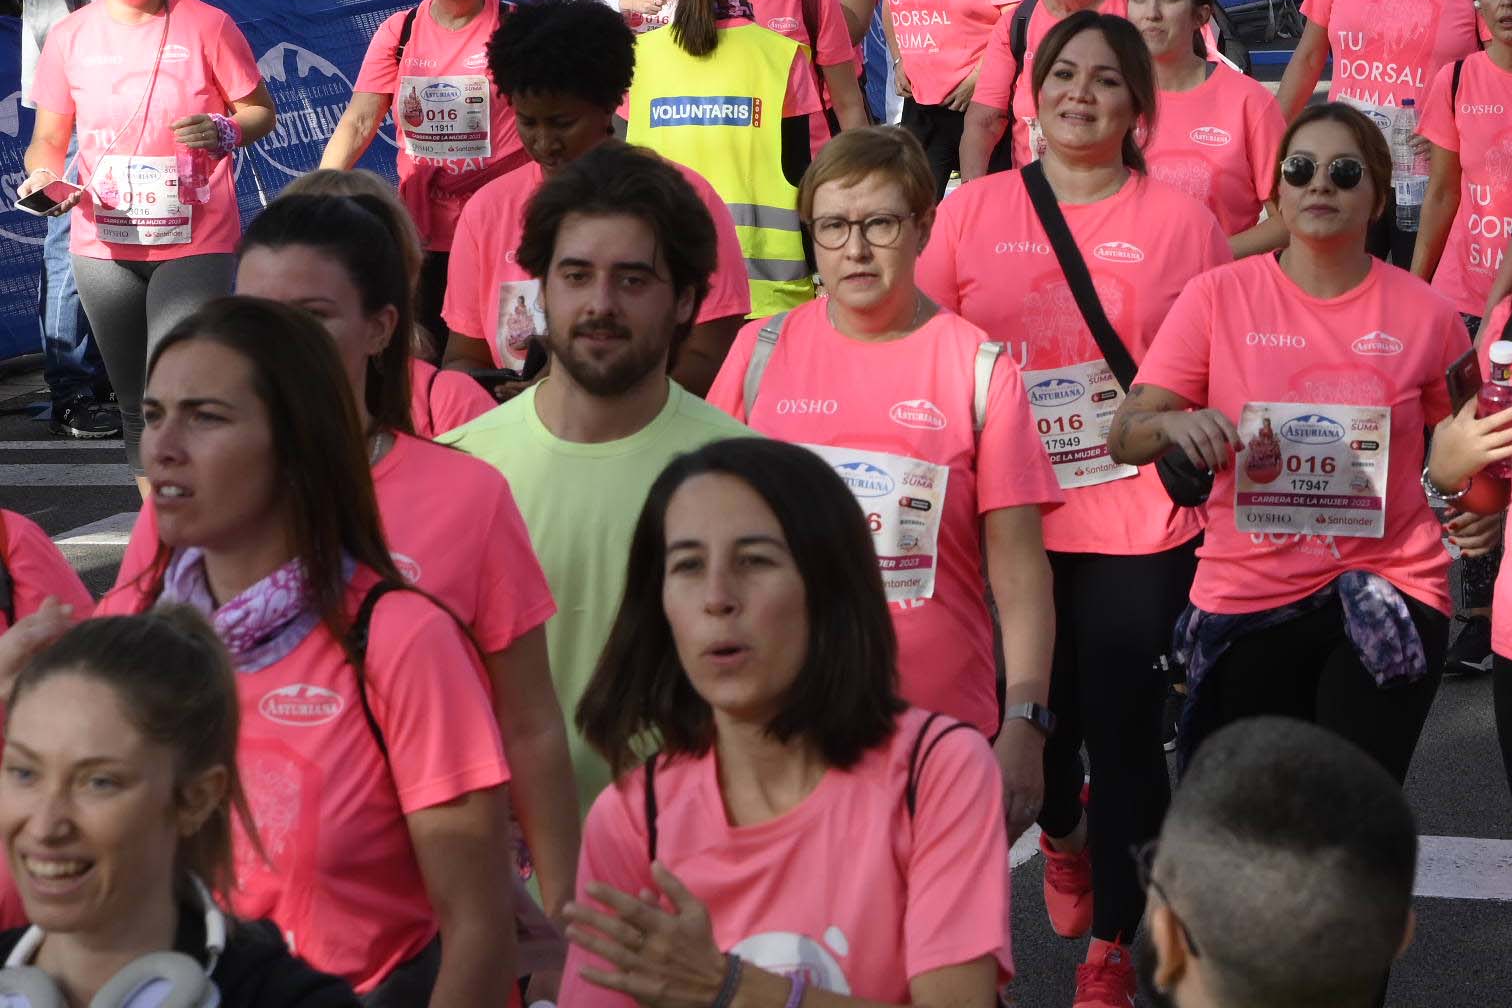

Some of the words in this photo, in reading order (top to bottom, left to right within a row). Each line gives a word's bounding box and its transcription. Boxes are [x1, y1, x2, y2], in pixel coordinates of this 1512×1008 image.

[646, 16, 669, 25] 016
[892, 10, 951, 27] DORSAL
[895, 31, 937, 50] SUMA
[1338, 31, 1363, 52] TU
[1340, 59, 1425, 89] DORSAL
[426, 108, 458, 122] 016
[652, 103, 749, 121] VOLUNTARIS
[1461, 103, 1505, 115] OYSHO
[430, 123, 455, 133] 11911
[1469, 183, 1491, 205] TU
[995, 240, 1050, 255] OYSHO
[1245, 331, 1307, 349] OYSHO
[1088, 373, 1114, 385] SUMA
[1028, 386, 1082, 402] ASTURIANA
[775, 398, 839, 415] OYSHO
[1037, 413, 1084, 435] 016
[1286, 424, 1342, 439] ASTURIANA
[1351, 422, 1380, 433] SUMA
[1044, 436, 1081, 451] 17949
[1064, 450, 1074, 460] LA
[1075, 448, 1101, 459] MUJER
[1286, 454, 1337, 475] 016
[902, 476, 934, 490] SUMA
[1290, 478, 1330, 492] 17947
[1251, 495, 1292, 506] CARRERA
[1293, 496, 1306, 505] DE
[1307, 496, 1319, 506] LA
[1319, 496, 1350, 507] MUJER
[1246, 512, 1293, 525] OYSHO
[1327, 514, 1374, 528] Santander
[265, 699, 338, 718] ASTURIANA
